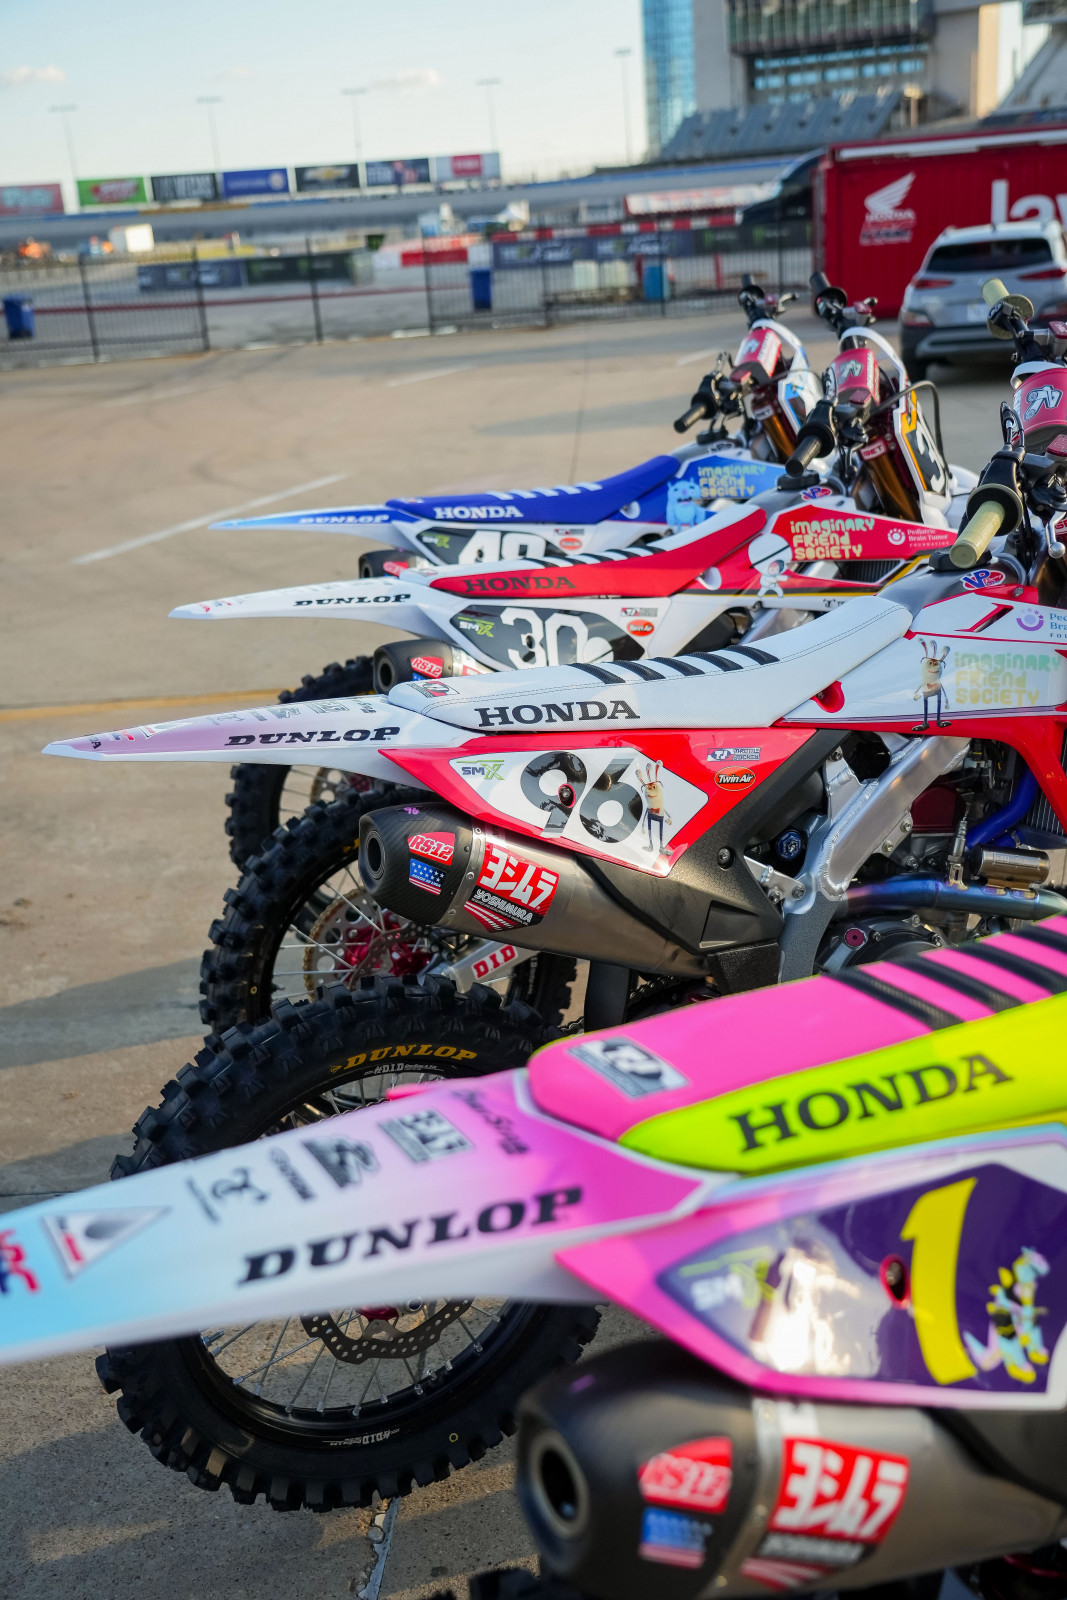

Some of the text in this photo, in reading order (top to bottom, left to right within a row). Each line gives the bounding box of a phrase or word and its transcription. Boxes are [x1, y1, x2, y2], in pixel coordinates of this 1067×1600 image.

[299, 514, 390, 524] DUNLOP
[433, 505, 523, 519] HONDA
[462, 576, 576, 593] HONDA
[962, 569, 990, 588] VP
[293, 593, 411, 606] DUNLOP
[459, 620, 495, 638] SMX
[500, 606, 589, 669] 30
[475, 700, 640, 727] HONDA
[225, 726, 401, 746] DUNLOP
[461, 762, 504, 781] SMX
[718, 773, 753, 783] Twin Air
[520, 751, 643, 843] 96
[480, 847, 556, 908] ヨシムラ
[474, 889, 533, 922] YOSHIMURA
[343, 1044, 478, 1071] DUNLOP
[729, 1053, 1014, 1153] HONDA
[238, 1185, 584, 1287] DUNLOP
[900, 1176, 978, 1385] 1
